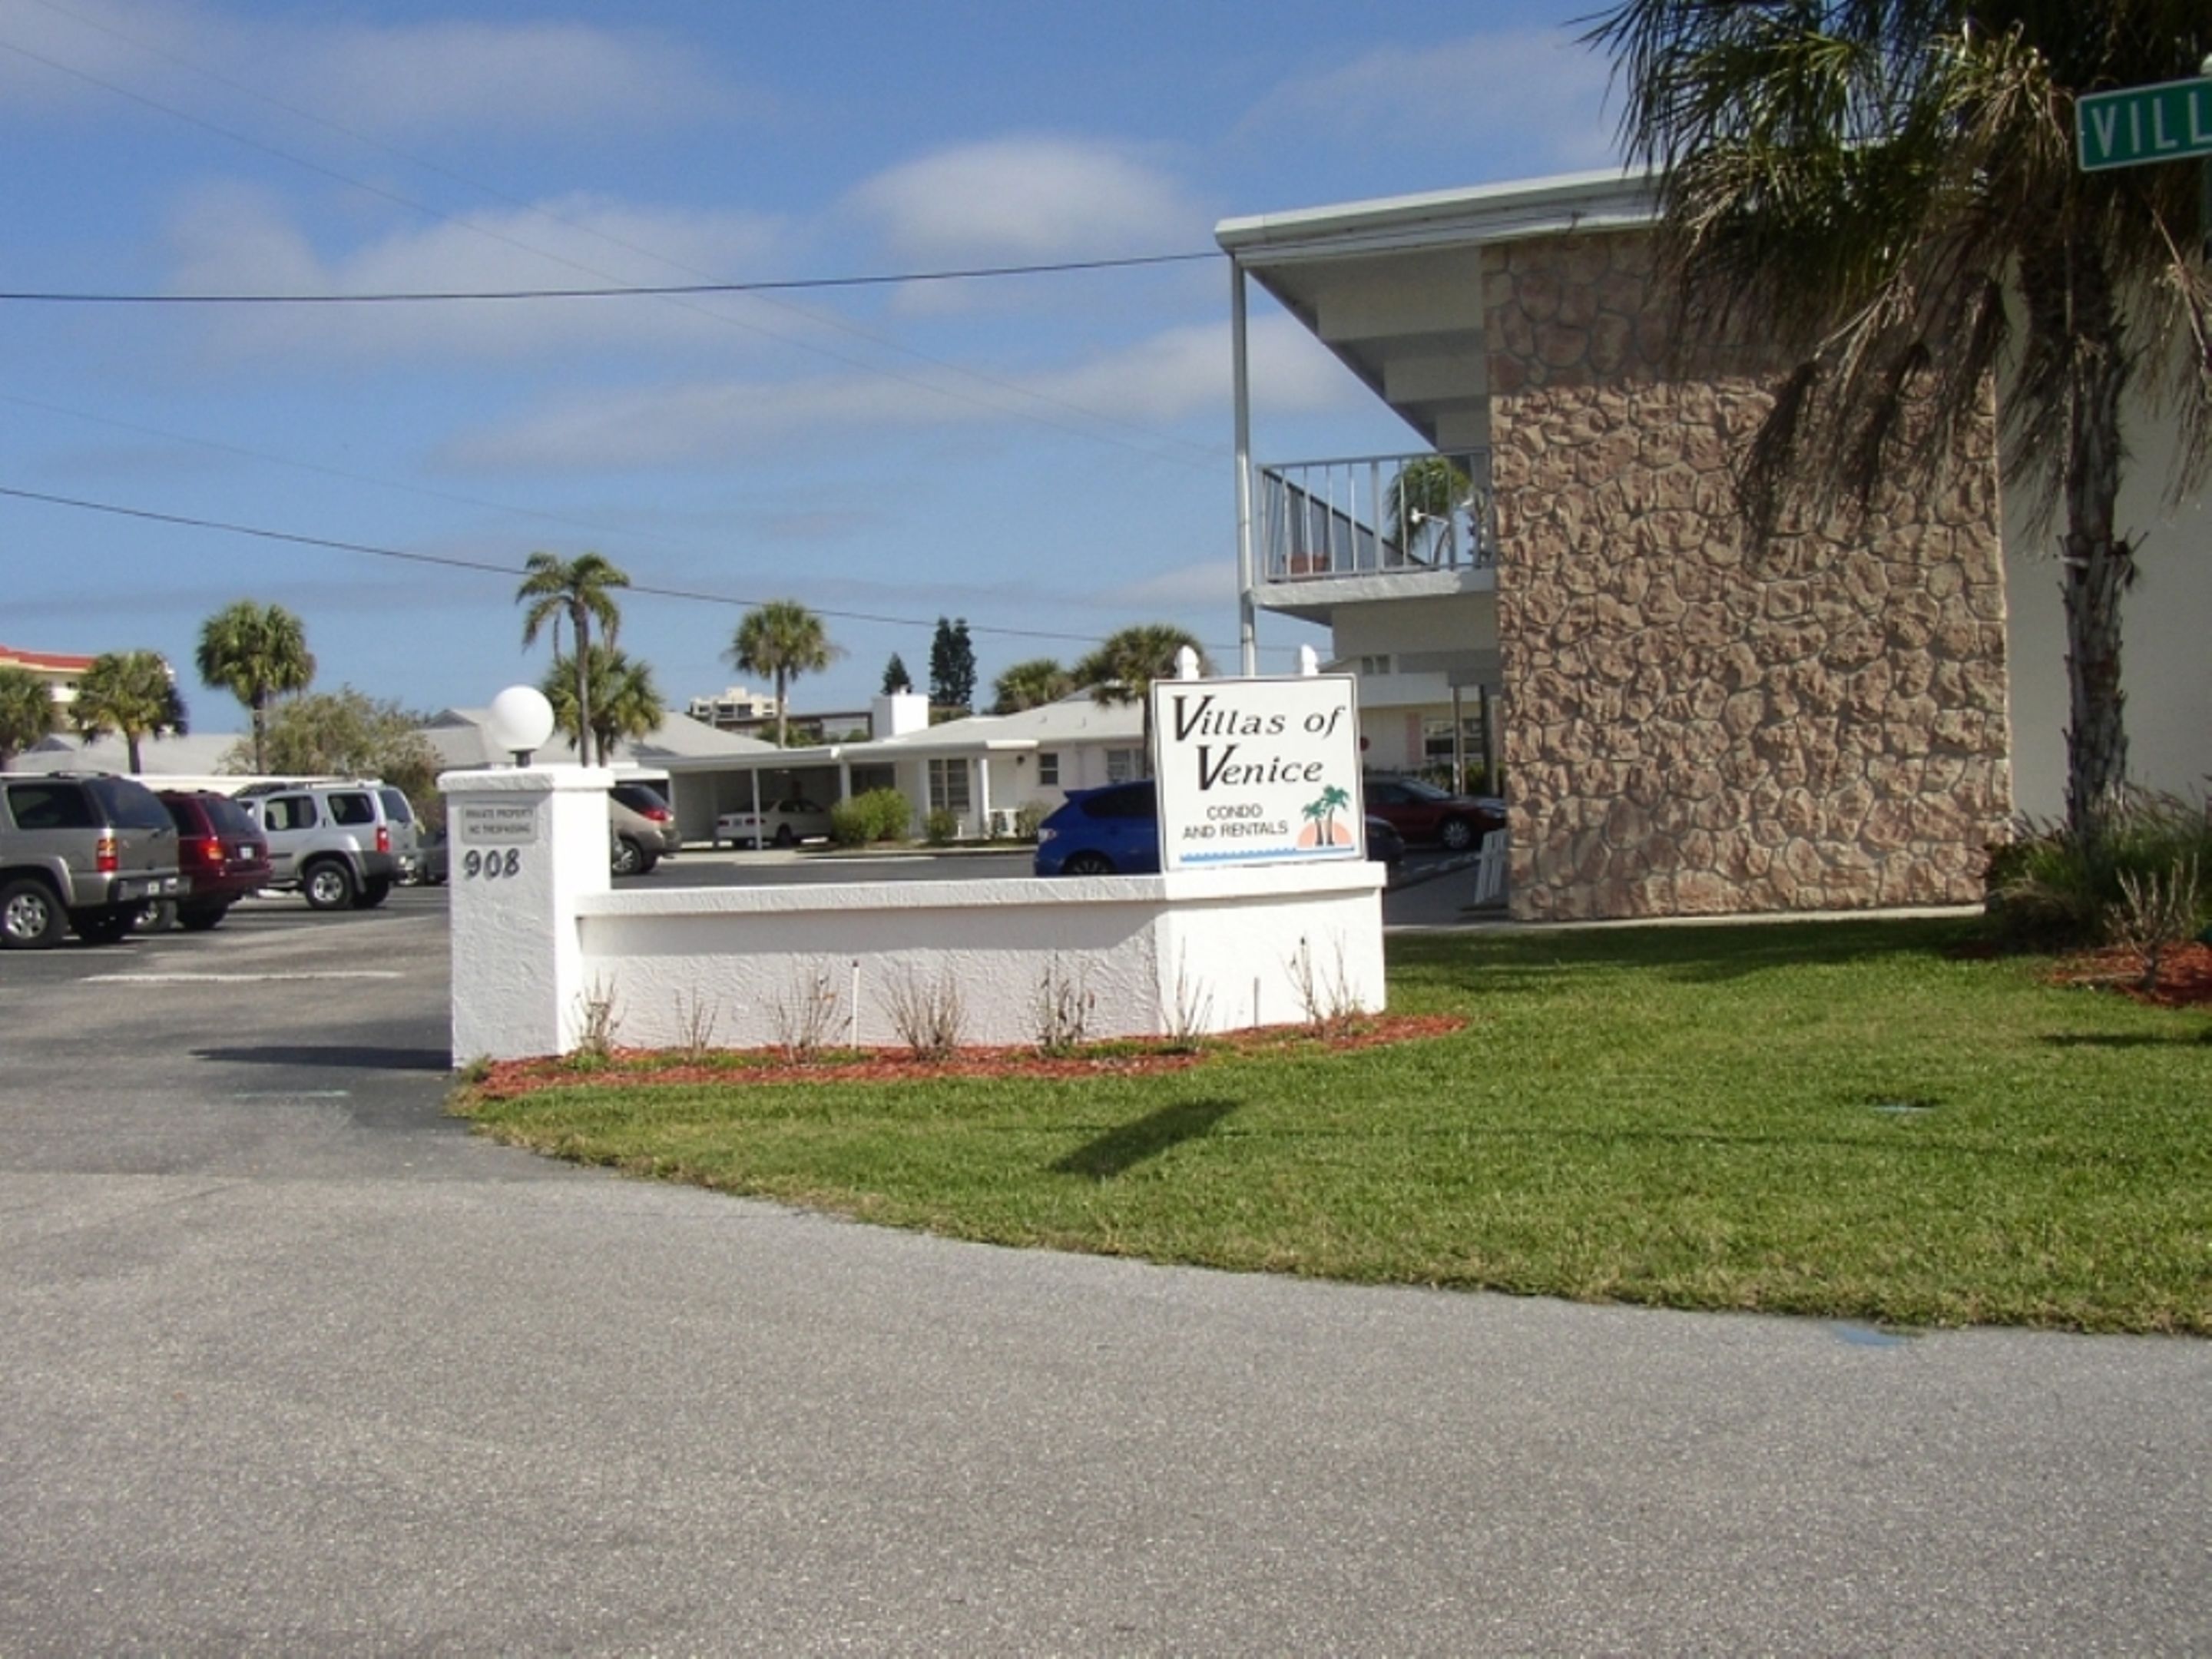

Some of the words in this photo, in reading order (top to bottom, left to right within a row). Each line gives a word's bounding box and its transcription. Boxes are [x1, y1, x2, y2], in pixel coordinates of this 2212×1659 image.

[2091, 91, 2212, 158] VILL
[1173, 694, 1286, 742] Villas
[1303, 705, 1346, 738] of
[1197, 743, 1323, 791] Venice
[1182, 825, 1216, 840] AND
[1220, 820, 1288, 838] RENTALS
[1206, 803, 1263, 820] CONDO
[463, 848, 520, 879] 908
